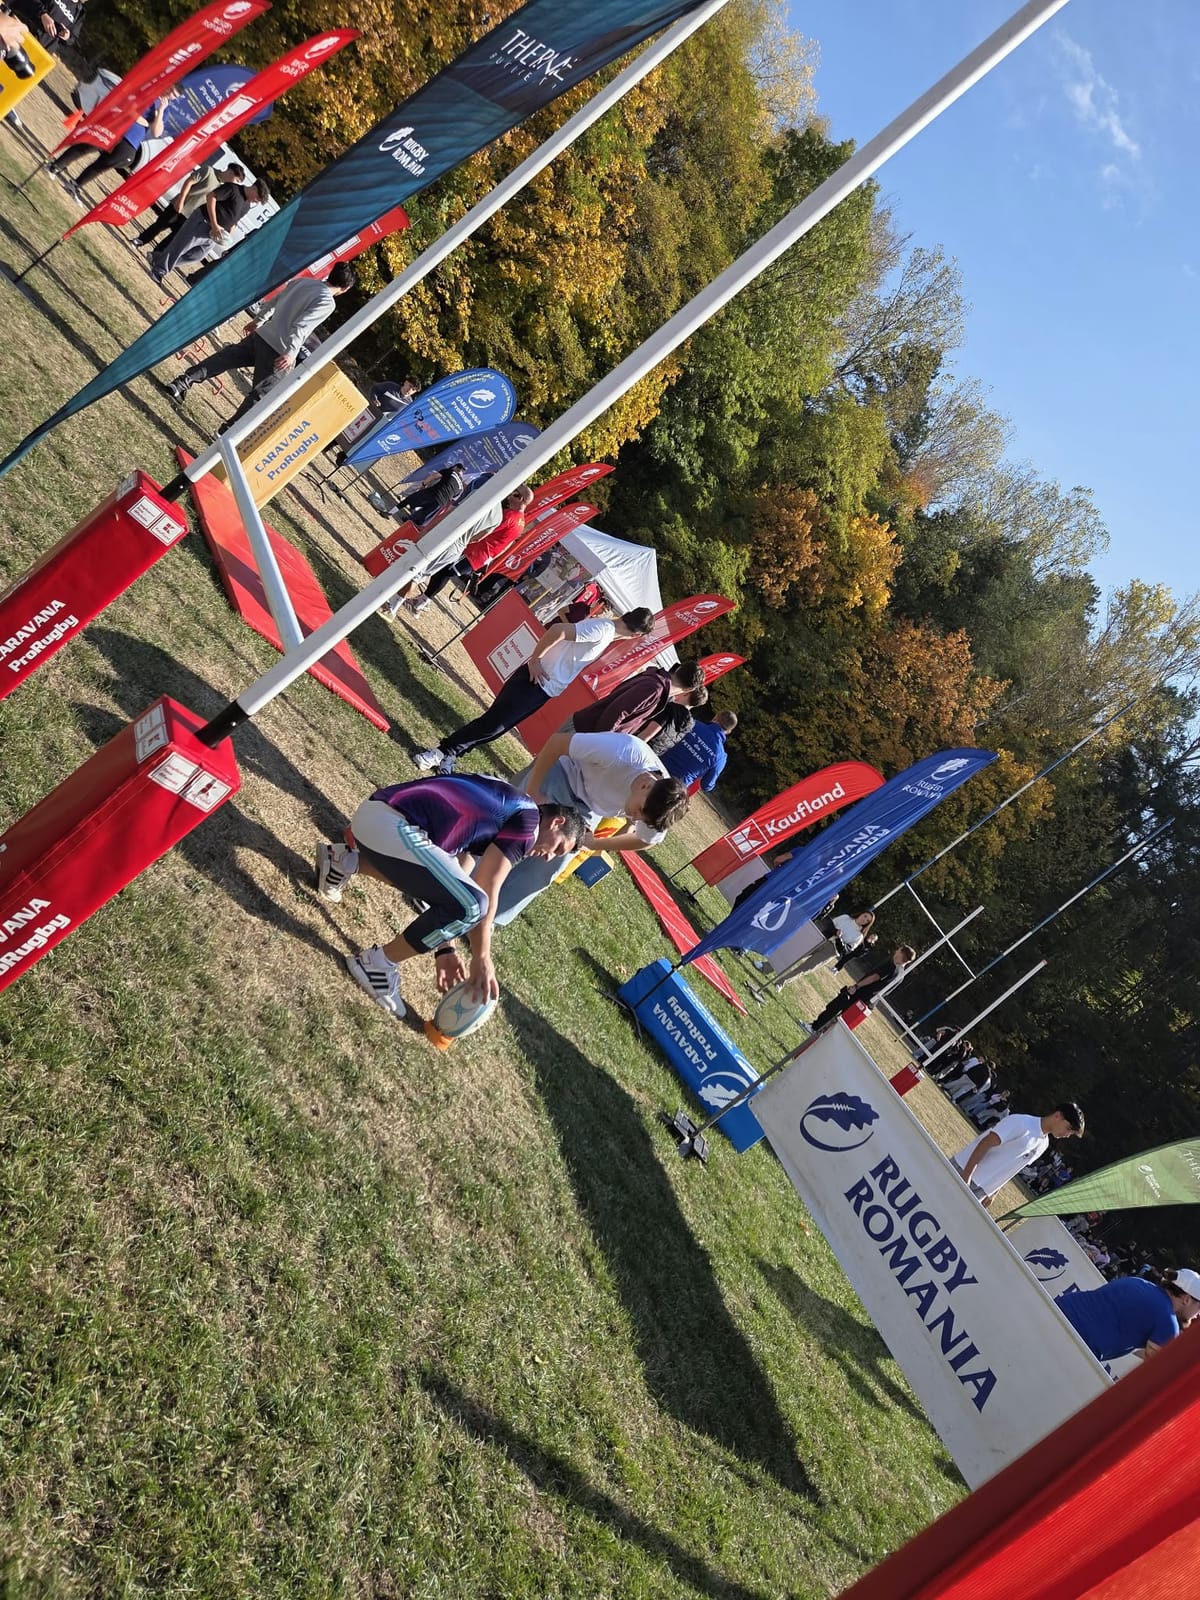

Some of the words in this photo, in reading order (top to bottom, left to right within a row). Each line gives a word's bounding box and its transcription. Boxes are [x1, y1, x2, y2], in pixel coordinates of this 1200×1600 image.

[402, 137, 429, 160] RUGBY
[331, 385, 356, 412] THERME
[451, 400, 475, 430] ProRugby
[455, 395, 482, 426] CARAVANA
[254, 419, 311, 474] CARAVANA
[267, 432, 320, 481] ProRugby
[0, 599, 66, 662] ARAVANA
[8, 613, 79, 673] ProRugby
[764, 782, 846, 837] Kaufland
[652, 1002, 708, 1074] CARAVANA
[666, 995, 718, 1061] ProRugby
[869, 1153, 979, 1295] RUGBY
[843, 1176, 998, 1413] ROMANIA
